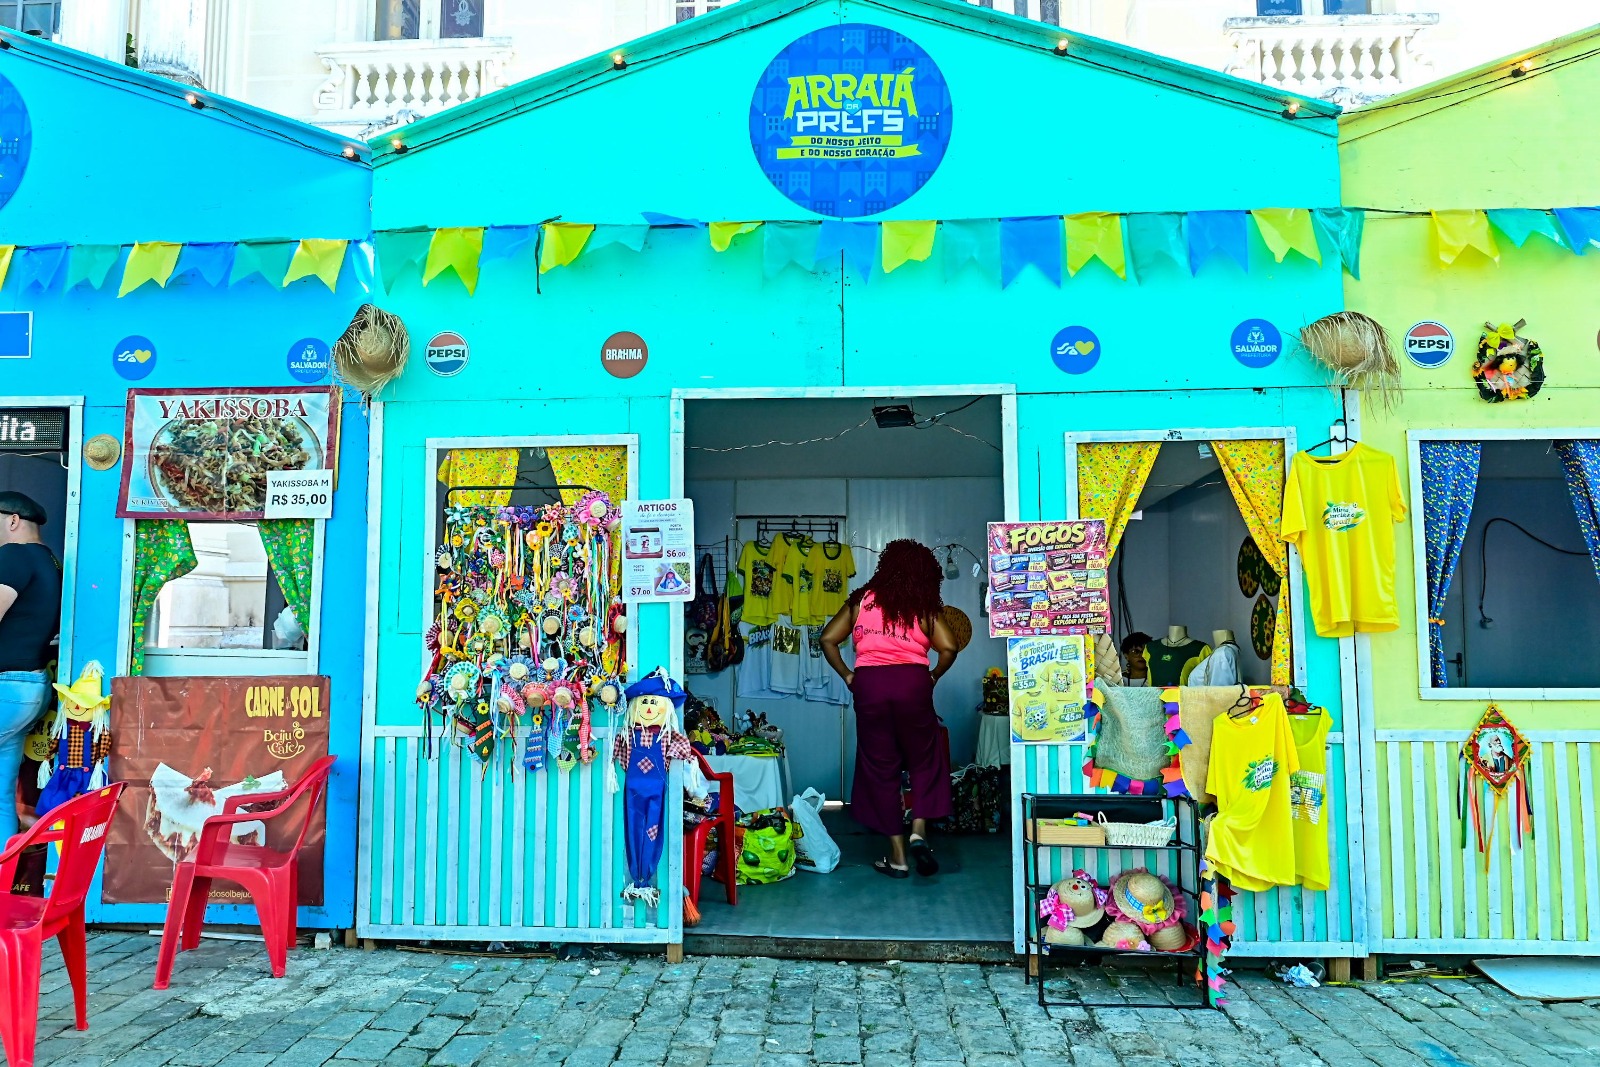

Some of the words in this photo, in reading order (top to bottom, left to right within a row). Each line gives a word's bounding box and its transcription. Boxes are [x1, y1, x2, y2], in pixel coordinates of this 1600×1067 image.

[783, 67, 918, 121] ARRAIÁ
[796, 110, 904, 133] PREFS
[826, 138, 854, 146] NOSSO
[858, 137, 882, 145] JEITO
[855, 148, 896, 157] CORAÇÃO
[1408, 340, 1450, 350] PEPSI
[428, 348, 466, 358] PEPSI
[606, 349, 642, 360] BRAHMA
[158, 398, 308, 419] YAKISSOBA
[0, 415, 36, 441] ita
[271, 494, 288, 506] R$
[291, 494, 327, 506] 35,00
[638, 504, 677, 512] ARTIGOS
[1009, 523, 1086, 553] FOGOS
[1030, 643, 1055, 655] TORCIDA
[1020, 649, 1058, 670] BRASIL!
[245, 686, 284, 718] CARNE
[290, 686, 322, 718] SOL
